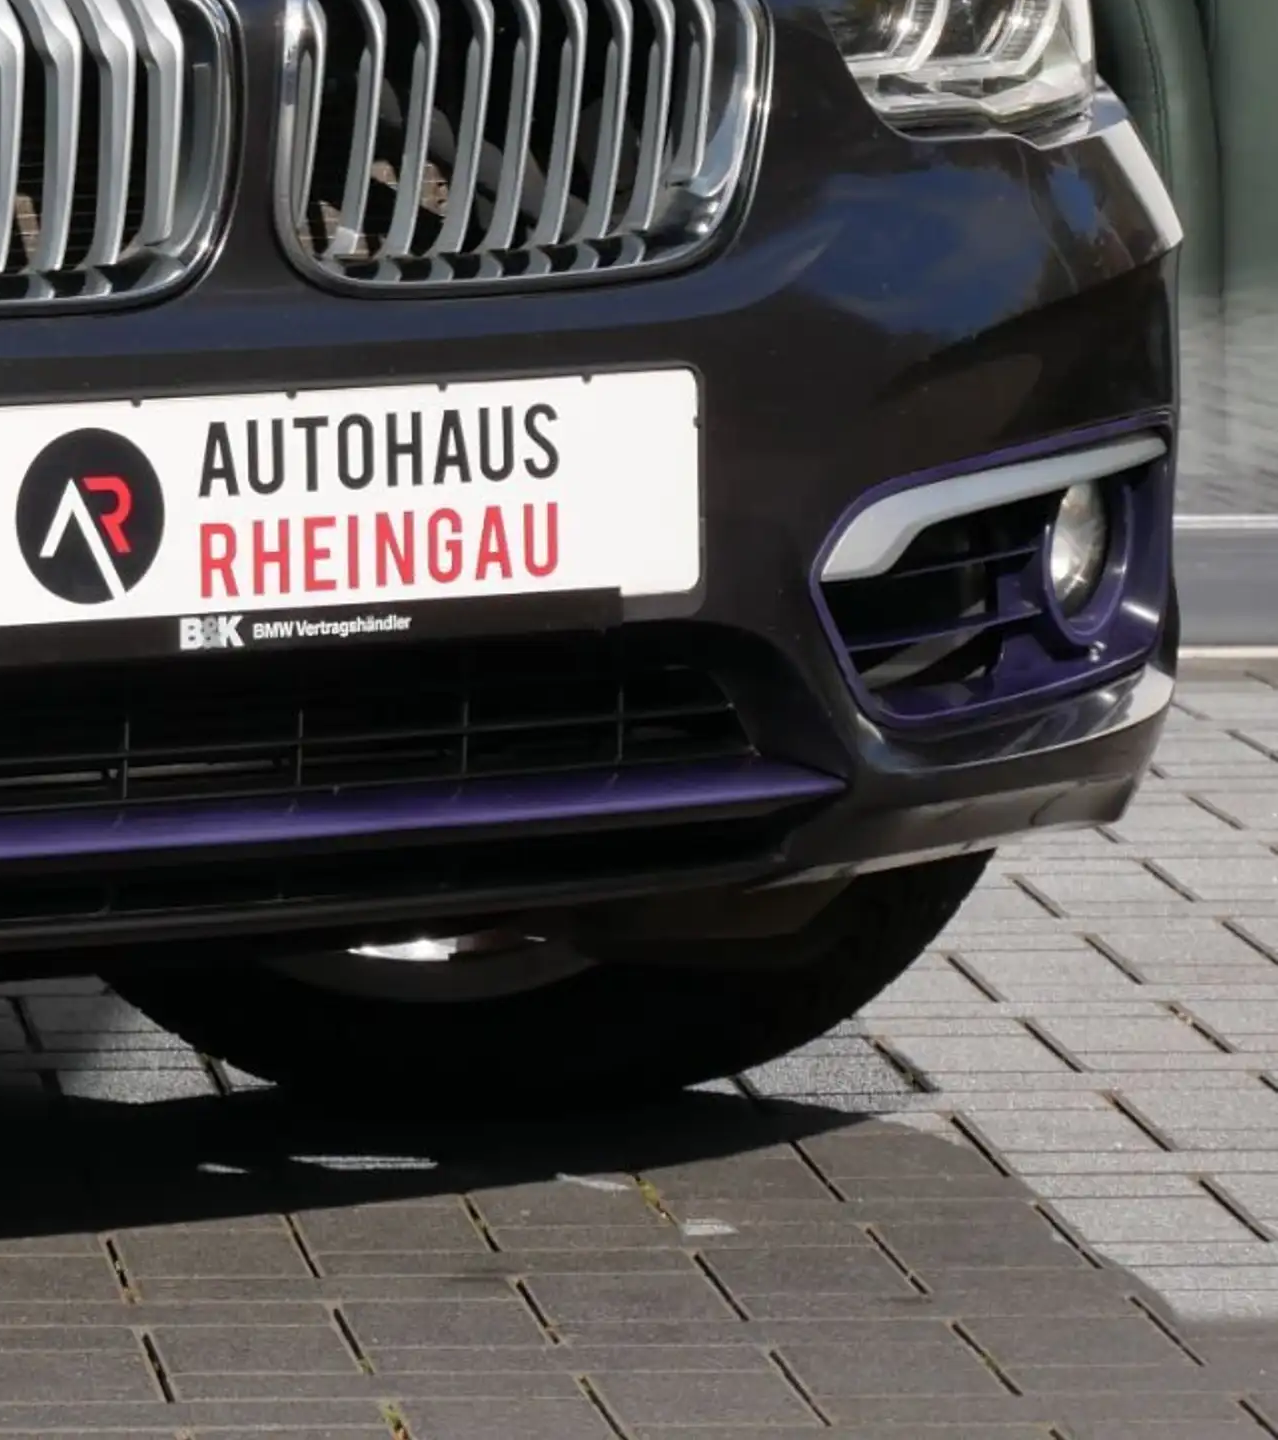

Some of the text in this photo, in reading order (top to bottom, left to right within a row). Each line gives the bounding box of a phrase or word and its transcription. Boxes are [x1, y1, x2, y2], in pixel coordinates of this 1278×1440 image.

[198, 402, 560, 498] AUTOHAUS
[198, 501, 560, 600] RHEINGAU
[179, 614, 412, 651] B&K BMW Vertragshändler
